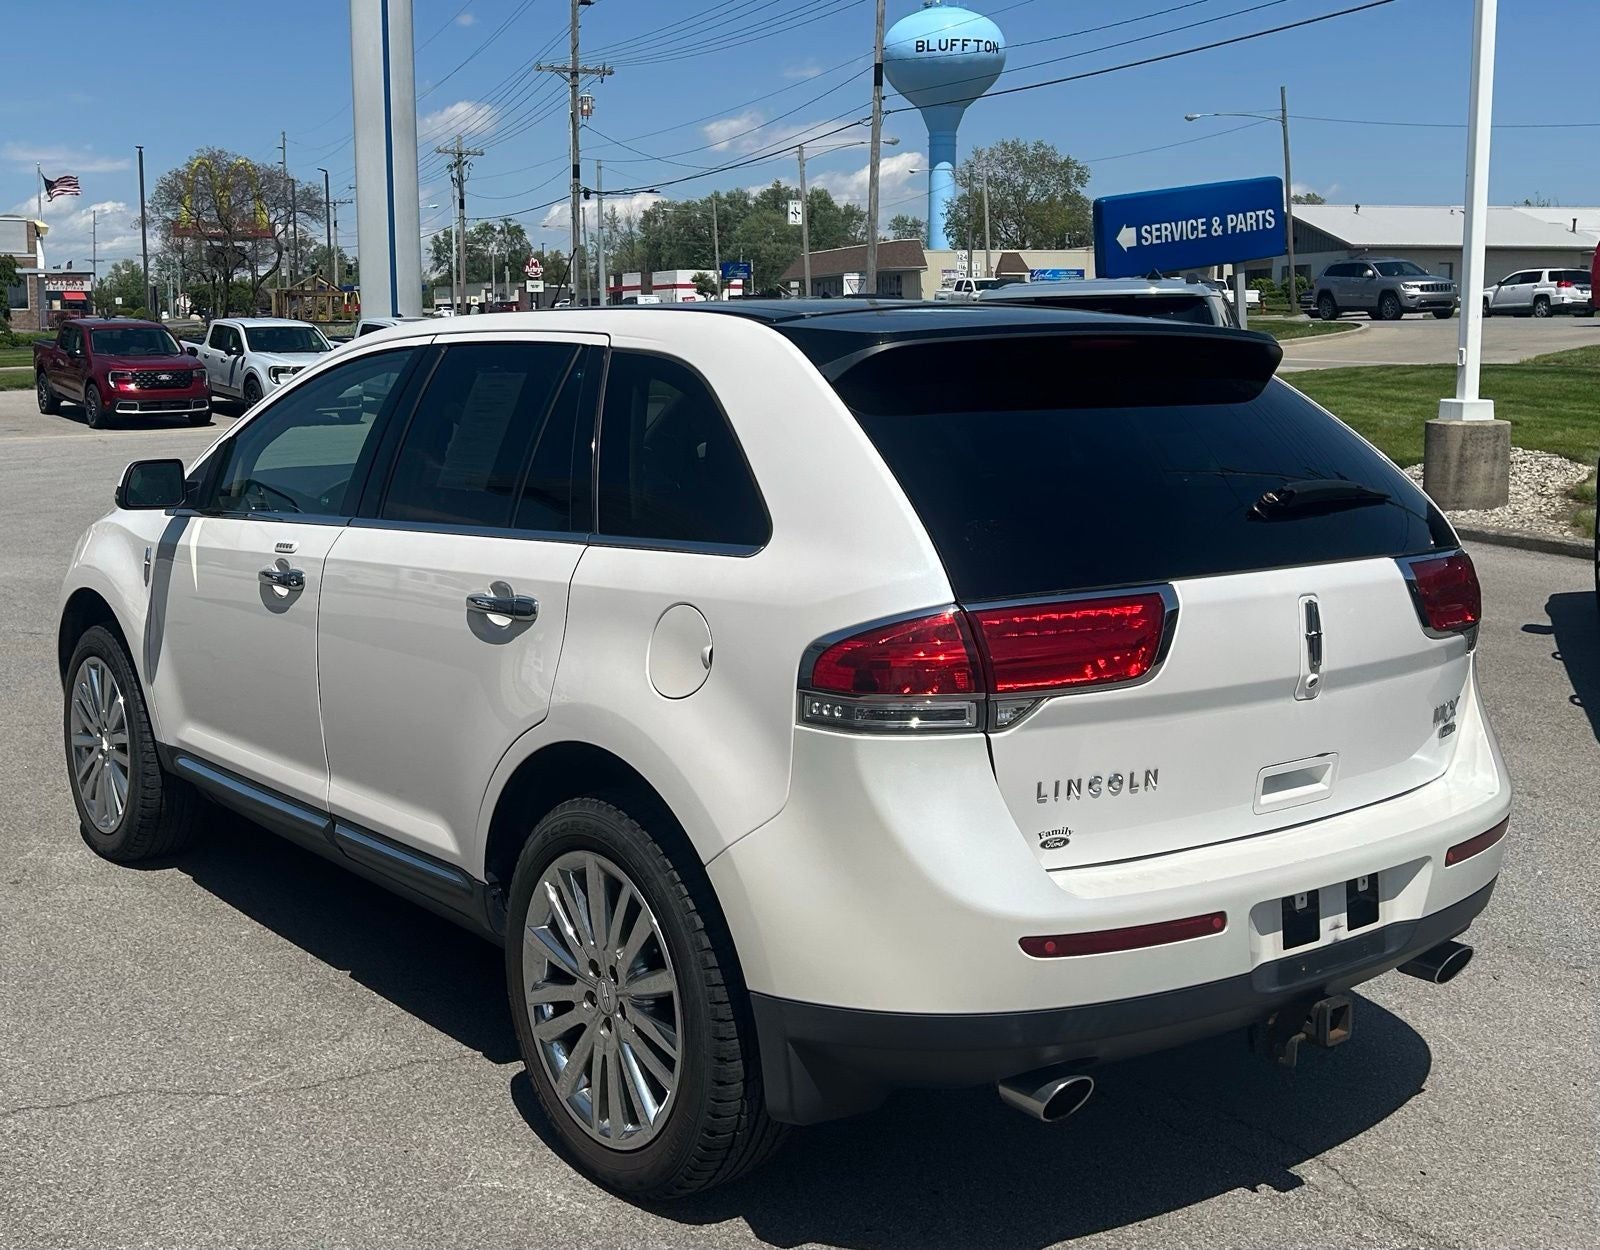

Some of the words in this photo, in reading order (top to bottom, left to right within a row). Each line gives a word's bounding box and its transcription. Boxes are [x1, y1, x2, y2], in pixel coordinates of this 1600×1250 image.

[916, 39, 999, 54] BLUFFTON
[1141, 218, 1207, 246] SERVICE
[1211, 216, 1223, 237] &
[1227, 208, 1276, 234] PARTS
[1036, 768, 1159, 804] LINCOLN
[1038, 826, 1074, 840] Family
[1044, 838, 1067, 849] Ford
